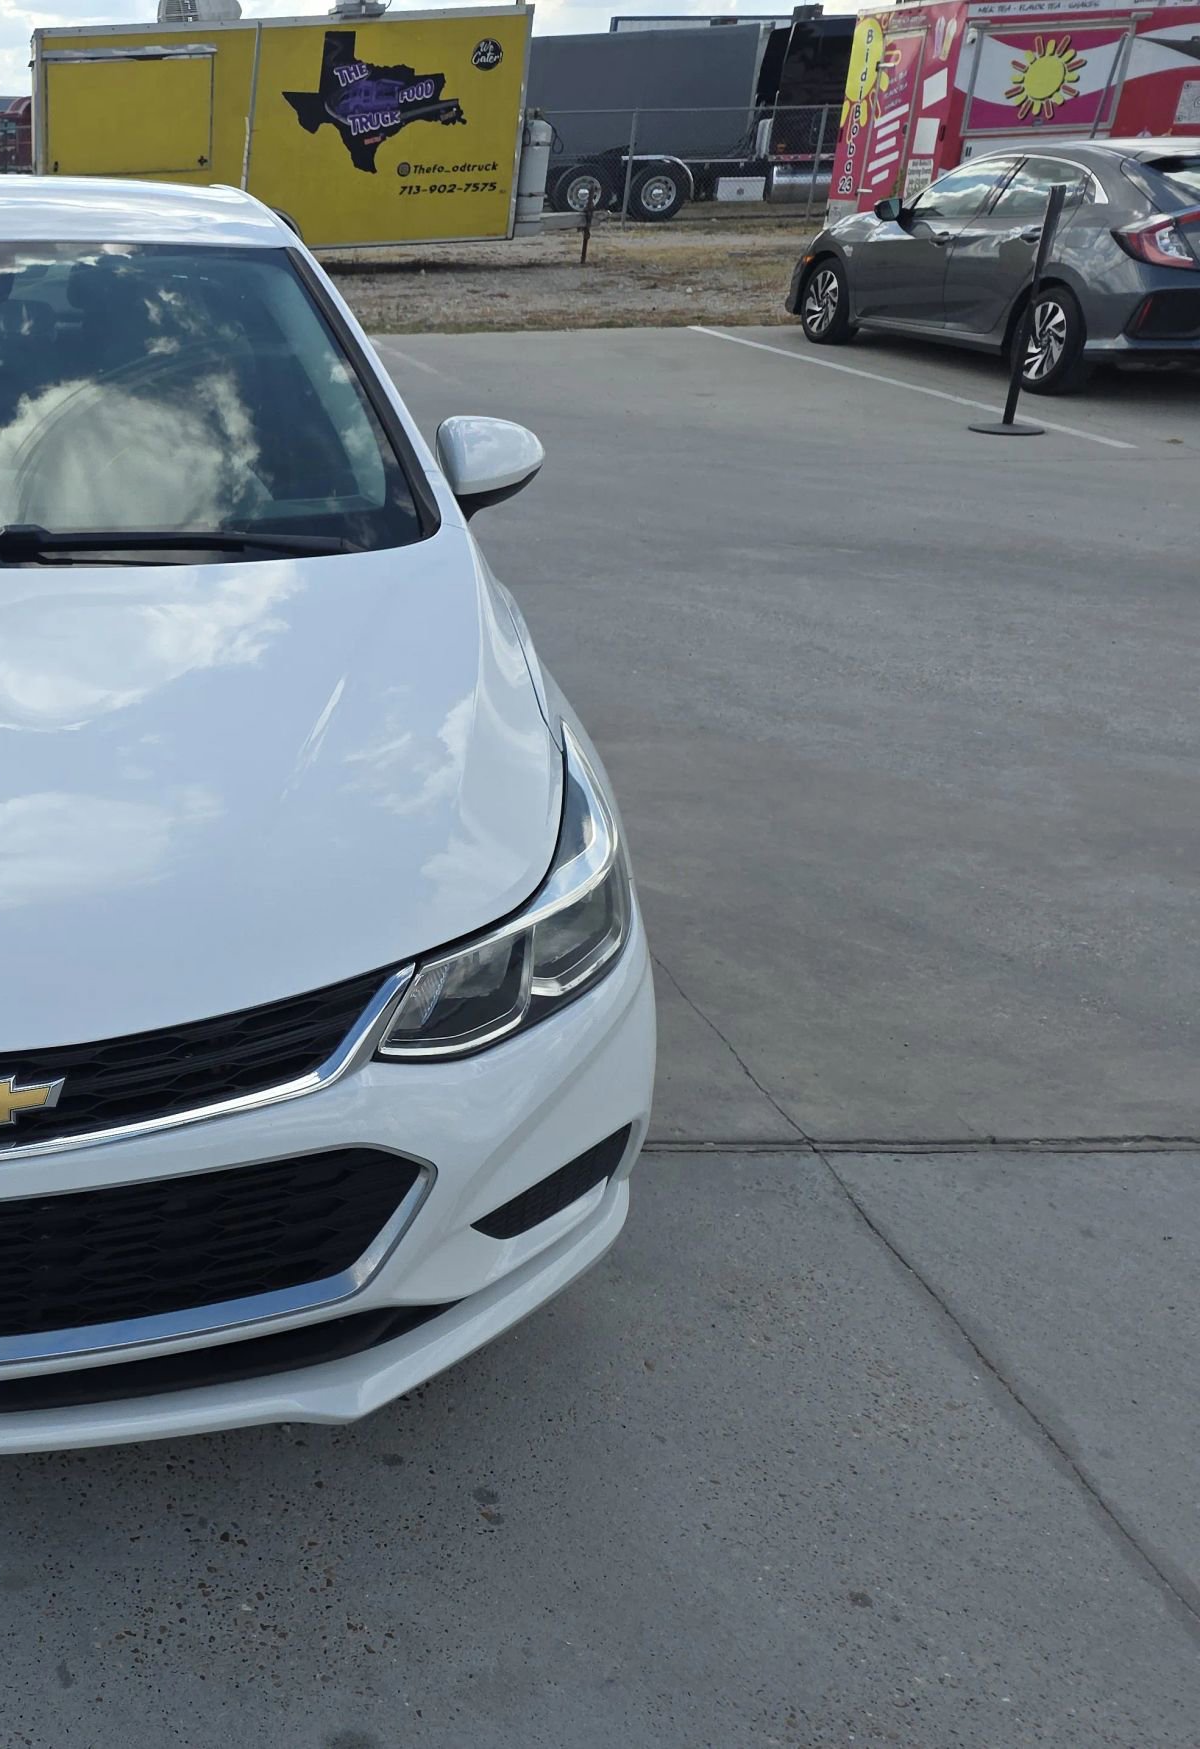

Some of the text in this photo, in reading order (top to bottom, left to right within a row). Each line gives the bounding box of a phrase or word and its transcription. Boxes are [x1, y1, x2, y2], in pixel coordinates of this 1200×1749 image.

[480, 40, 495, 52] We
[472, 50, 503, 65] Cater!
[333, 64, 369, 87] THE
[398, 79, 434, 103] FOOD
[837, 28, 875, 194] Bidi Boba 23
[347, 110, 400, 135] TRUCK
[412, 160, 499, 175] Thefo_odtruck
[398, 182, 498, 196] 713-902-7575
